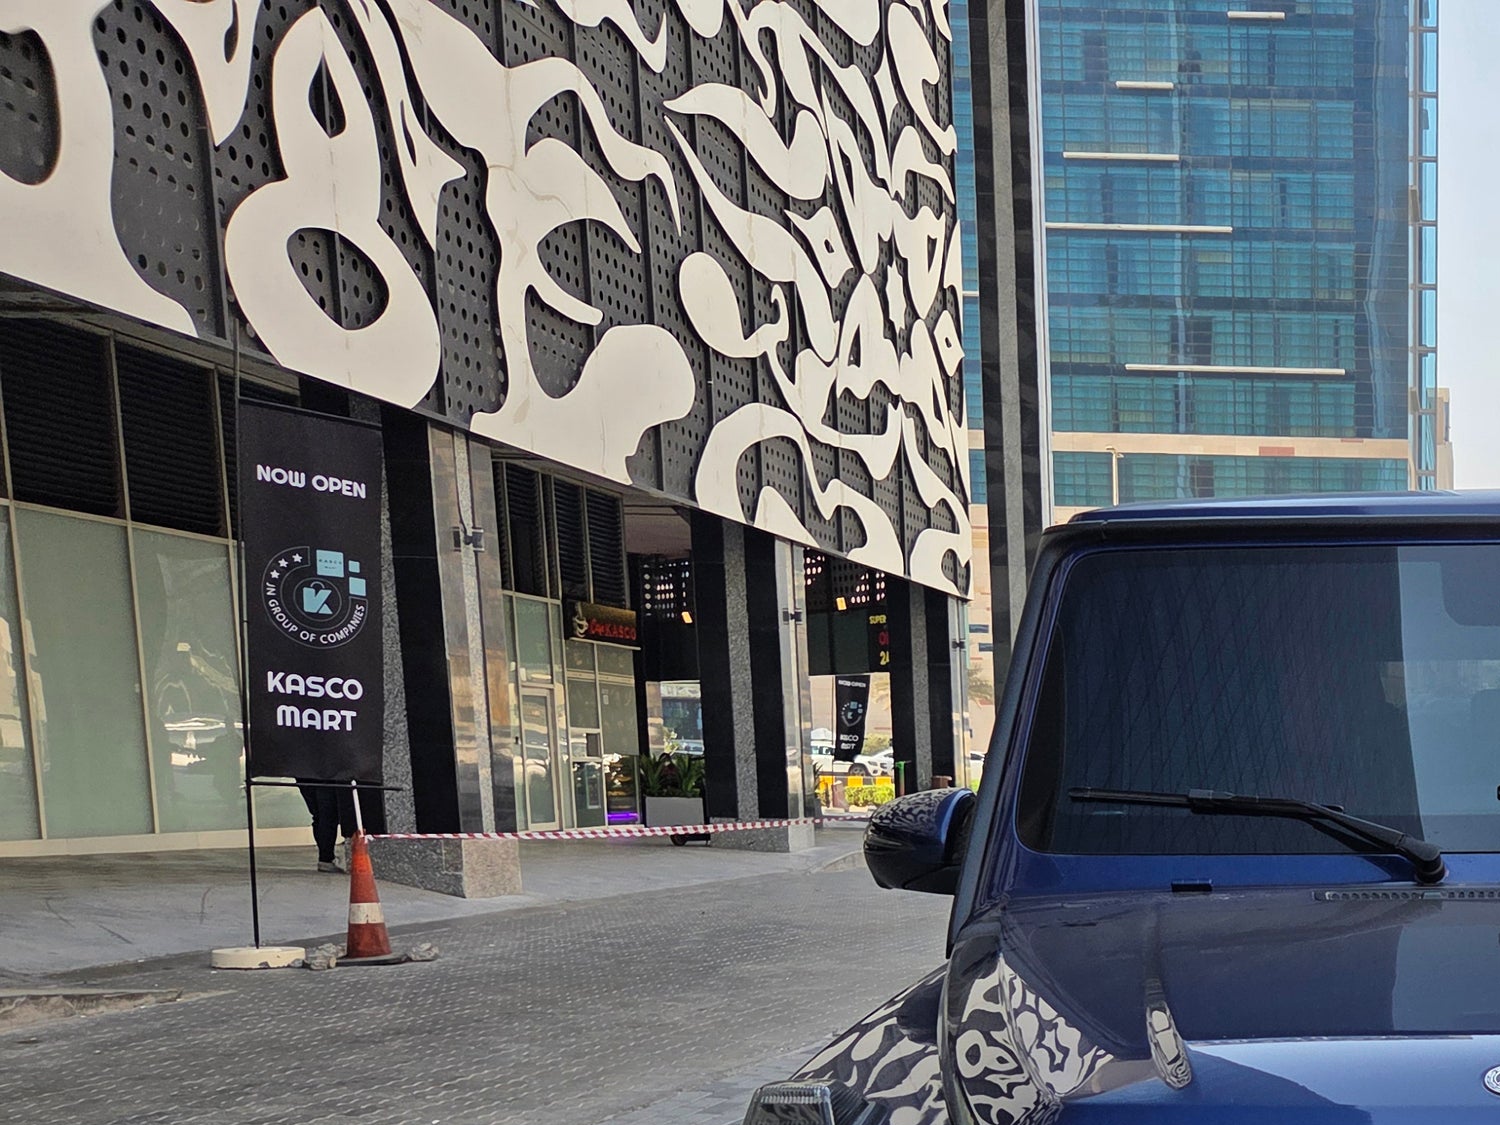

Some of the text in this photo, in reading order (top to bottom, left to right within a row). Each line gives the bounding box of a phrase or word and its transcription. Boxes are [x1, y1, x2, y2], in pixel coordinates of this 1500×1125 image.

[257, 464, 366, 499] NOW OPEN
[268, 599, 298, 632] GROUP
[300, 630, 317, 642] OF
[320, 604, 365, 644] COMPANIES
[267, 671, 363, 701] KASCO
[277, 705, 357, 731] MART
